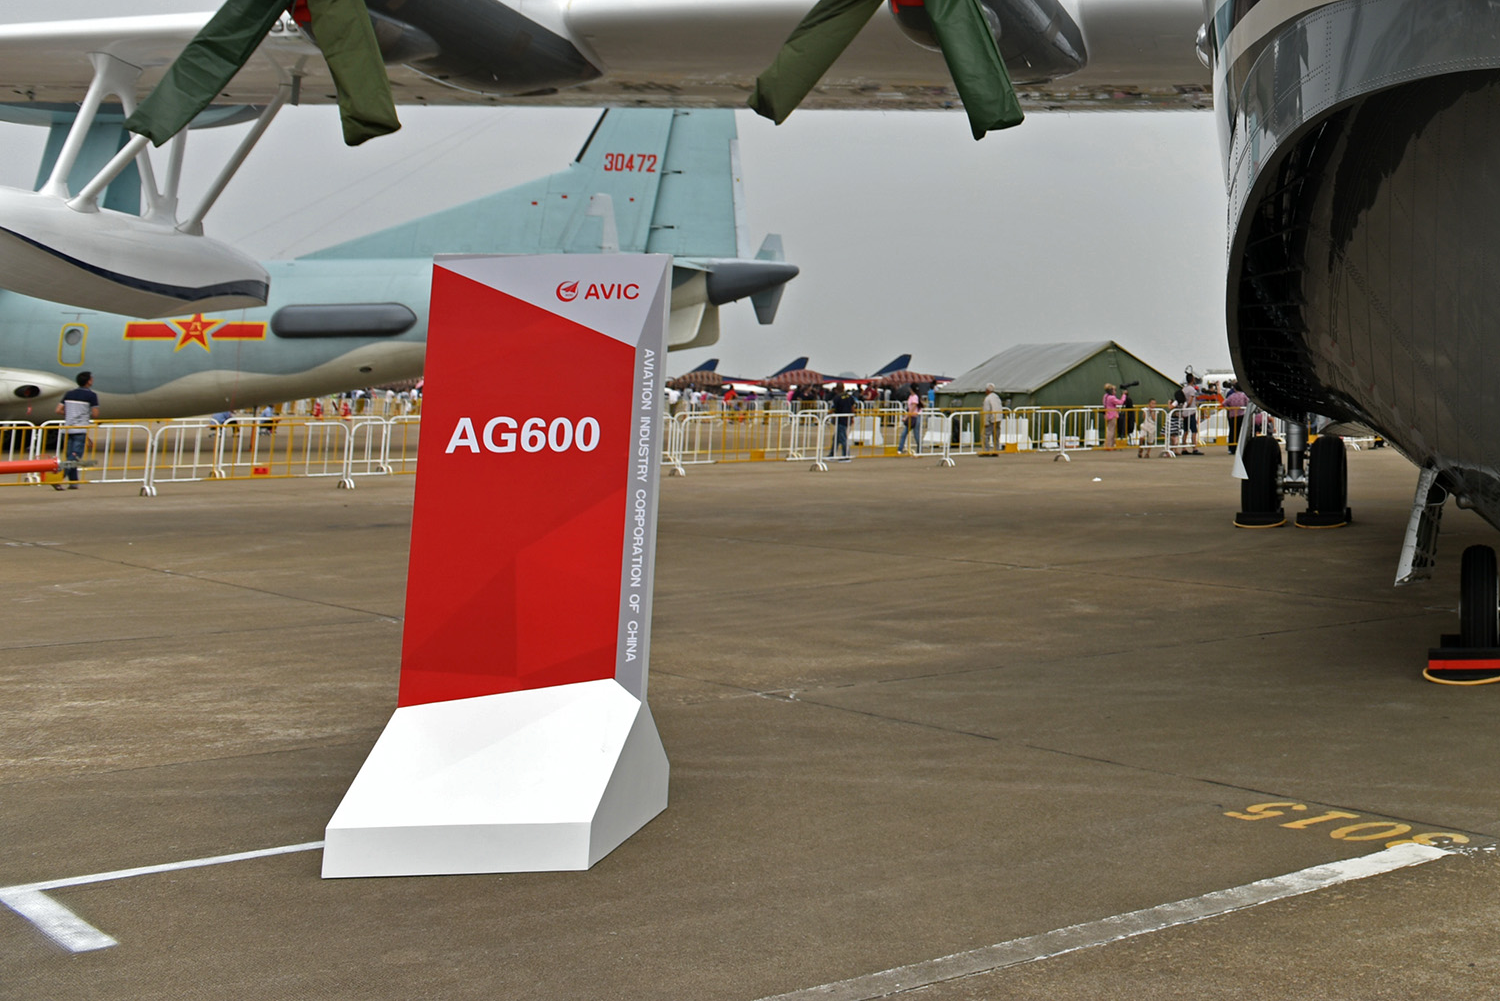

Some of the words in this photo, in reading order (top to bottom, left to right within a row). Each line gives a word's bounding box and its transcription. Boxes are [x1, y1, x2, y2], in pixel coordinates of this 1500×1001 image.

[603, 152, 658, 173] 30472
[584, 283, 640, 300] AVIC
[641, 348, 655, 410] AVIATION
[445, 416, 601, 454] AG600
[637, 416, 651, 483] INDUSTRY
[630, 489, 646, 587] CORPORATION
[629, 593, 641, 614] OF
[625, 620, 639, 662] CHINA
